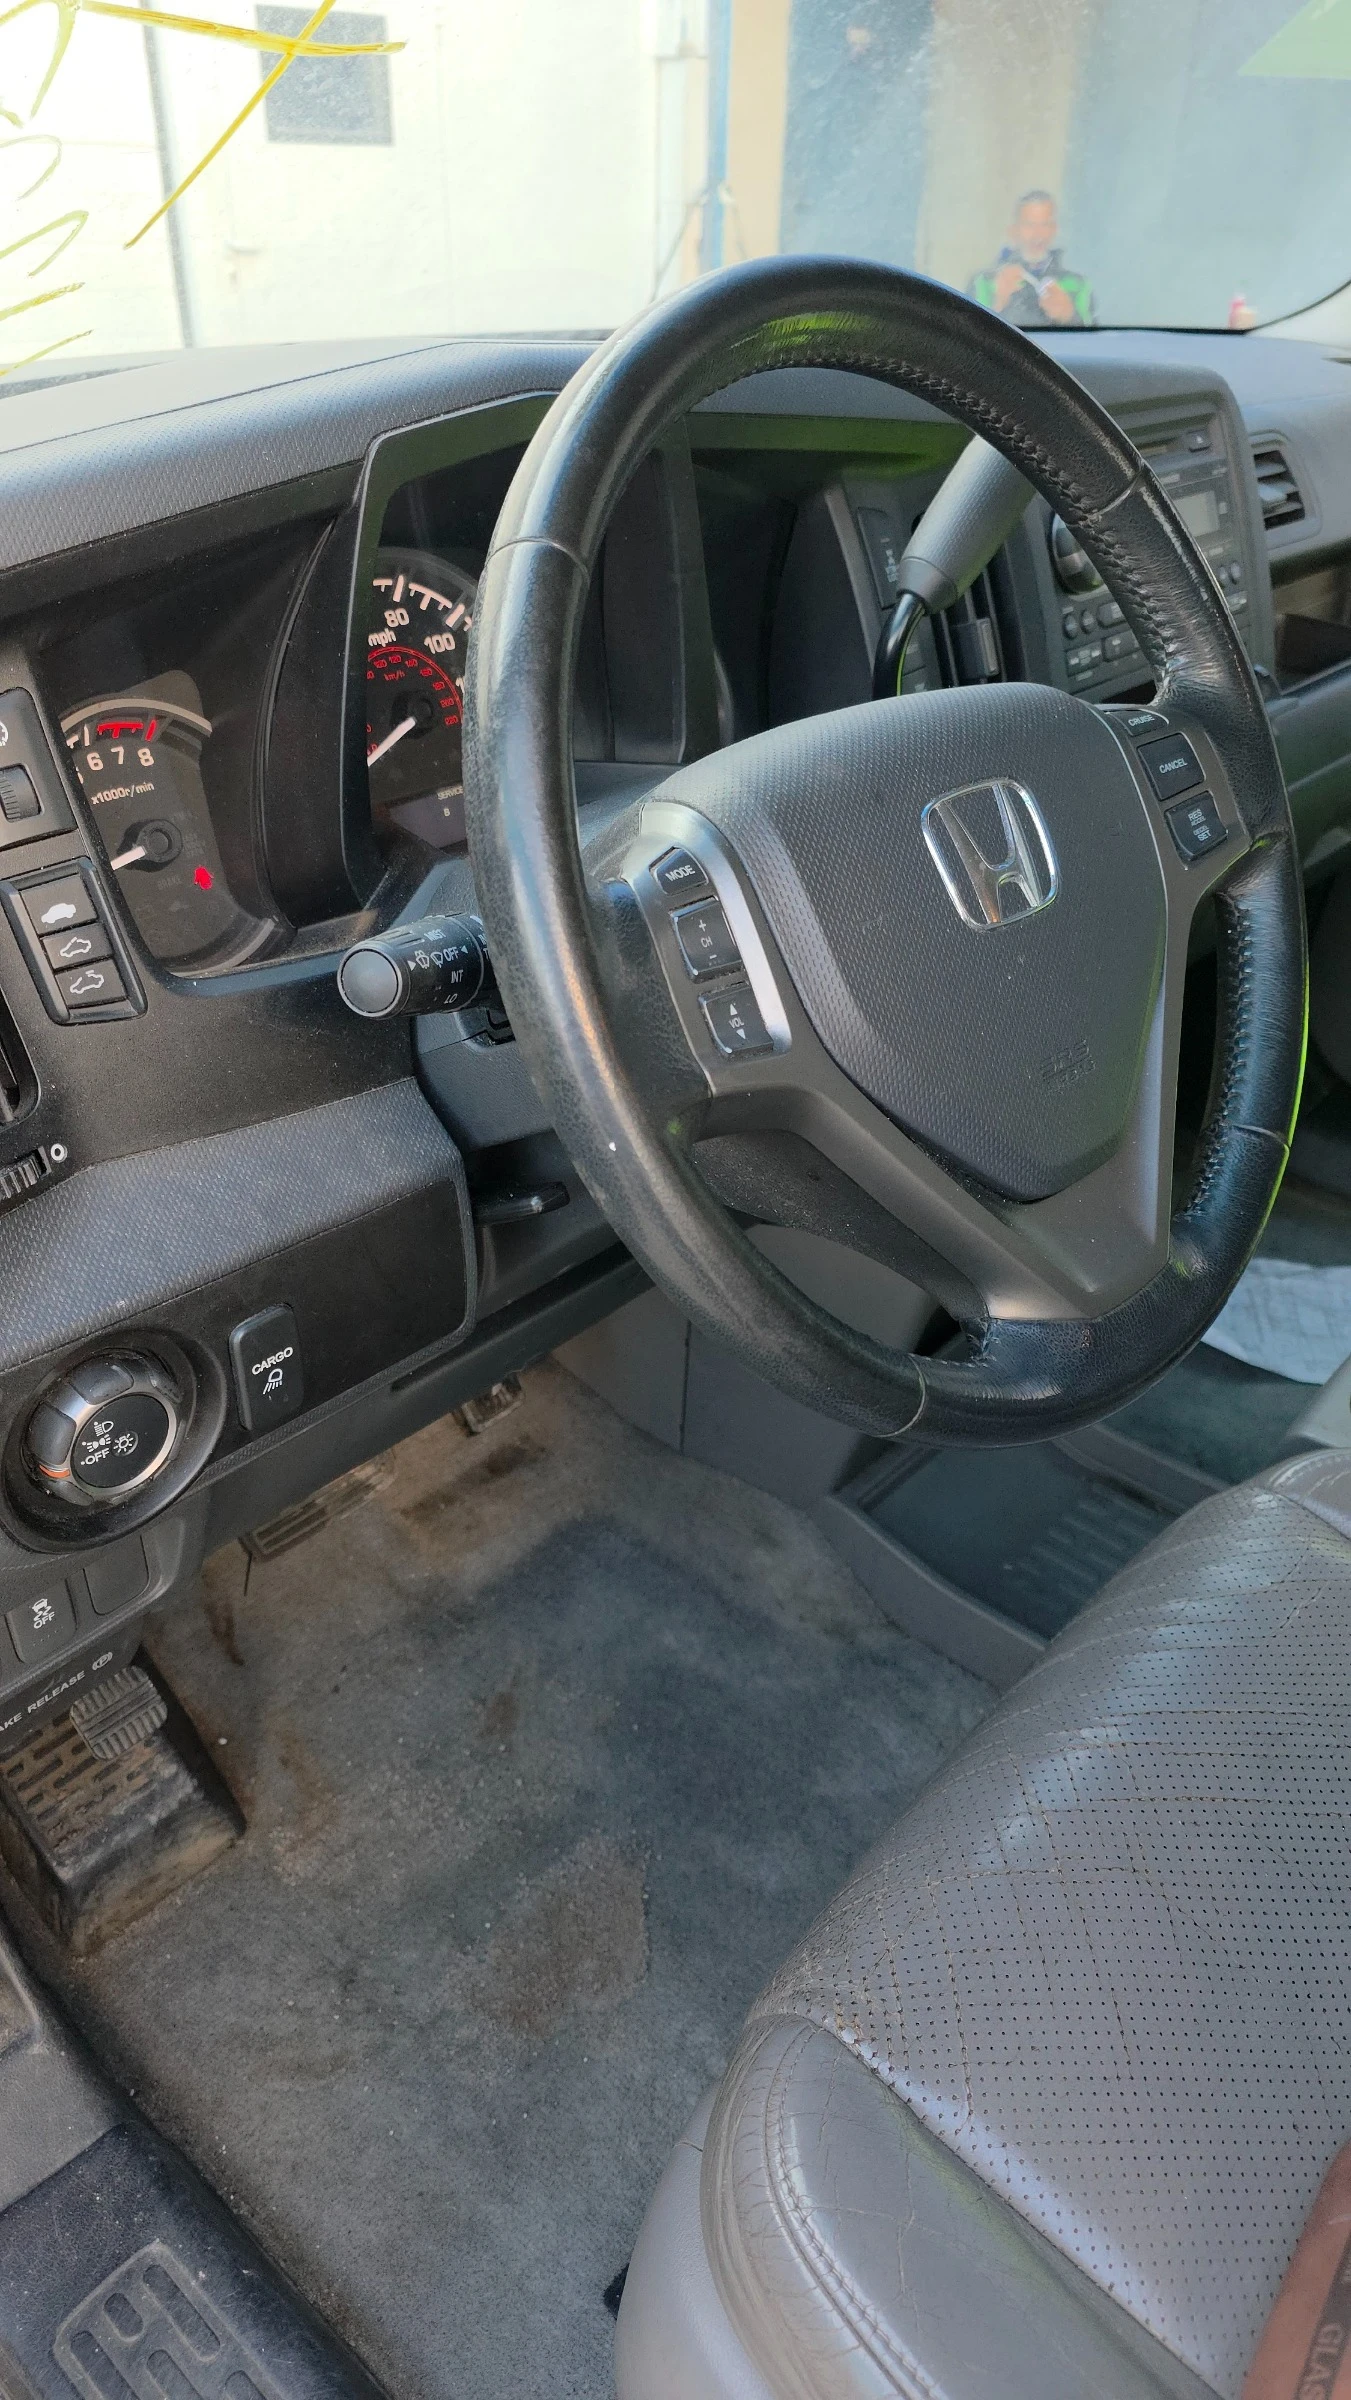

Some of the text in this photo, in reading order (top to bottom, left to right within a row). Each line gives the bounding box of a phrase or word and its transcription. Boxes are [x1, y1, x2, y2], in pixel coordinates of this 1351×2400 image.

[384, 608, 410, 628] 80
[368, 628, 397, 648] mph
[424, 632, 456, 655] 100
[1127, 714, 1155, 727] CRUISE
[87, 752, 104, 771] 6
[111, 746, 125, 765] 7
[137, 748, 155, 767] 8
[1159, 758, 1188, 774] CANCEL
[91, 780, 155, 805] x1000r/min
[1188, 808, 1203, 821] RES
[1197, 829, 1212, 841] SET
[665, 864, 696, 882] MODE
[424, 928, 447, 942] MIST
[701, 936, 713, 949] CH
[443, 946, 459, 962] OFF
[450, 969, 464, 984] INT
[443, 993, 458, 1005] LO
[729, 1018, 745, 1029] VOL
[252, 1347, 294, 1375] CARGO
[86, 1448, 110, 1466] OFF
[33, 1611, 55, 1629] OFF
[27, 1671, 86, 1714] RELEASE
